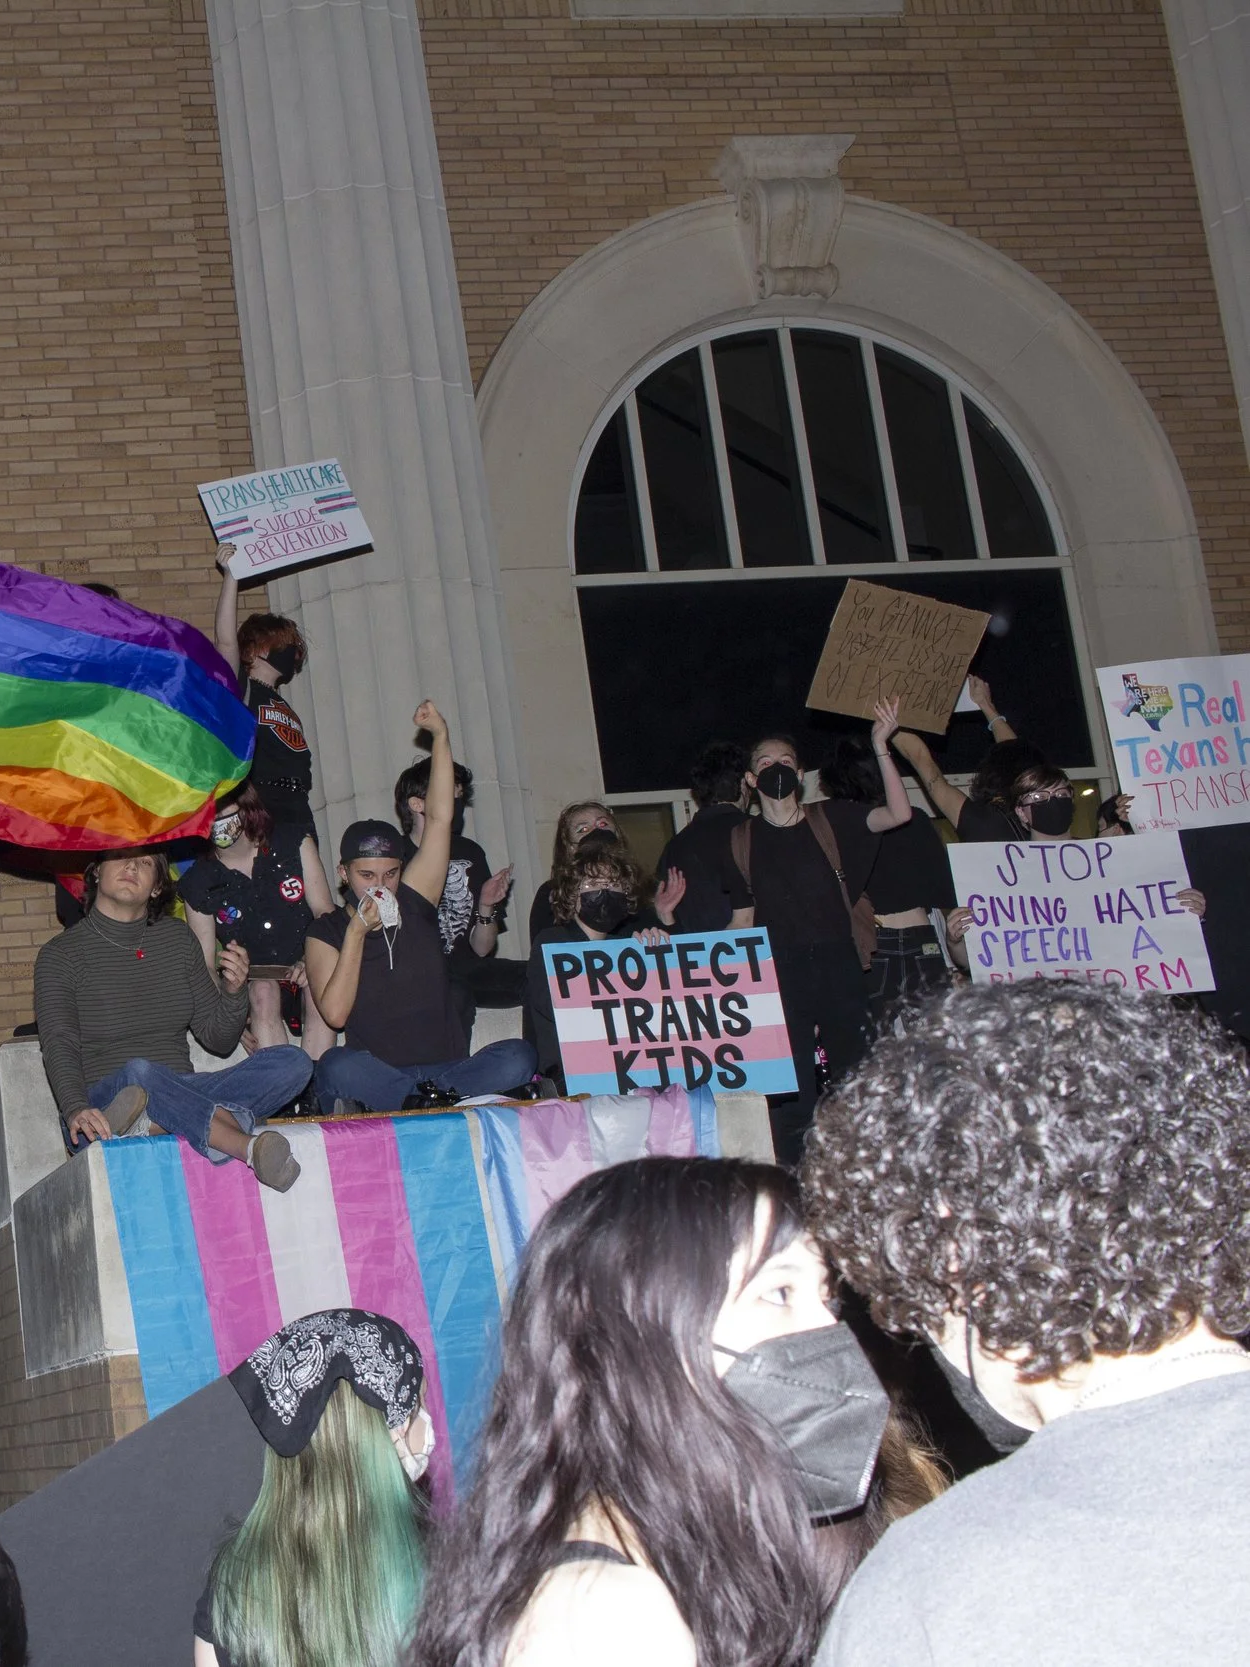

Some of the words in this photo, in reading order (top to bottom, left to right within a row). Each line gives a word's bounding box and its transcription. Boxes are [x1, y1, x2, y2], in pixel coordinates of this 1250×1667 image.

[202, 477, 266, 514] TRANS
[261, 464, 344, 498] HEALTHCARE
[269, 498, 288, 512] IS
[244, 521, 348, 565] PREVENTION
[254, 506, 323, 537] SUICIDE
[827, 661, 856, 701] OF
[1178, 680, 1246, 727] Real
[1115, 736, 1230, 778] Texans
[996, 842, 1112, 887] STOP
[967, 894, 1067, 927] GIVING
[1094, 881, 1185, 924] HATE
[552, 936, 765, 999] PROTECT
[977, 926, 1093, 968] SPEECH
[1132, 925, 1163, 959] A
[990, 957, 1192, 991] PTFORM
[592, 991, 751, 1046] TRANS
[613, 1043, 748, 1095] KIDS
